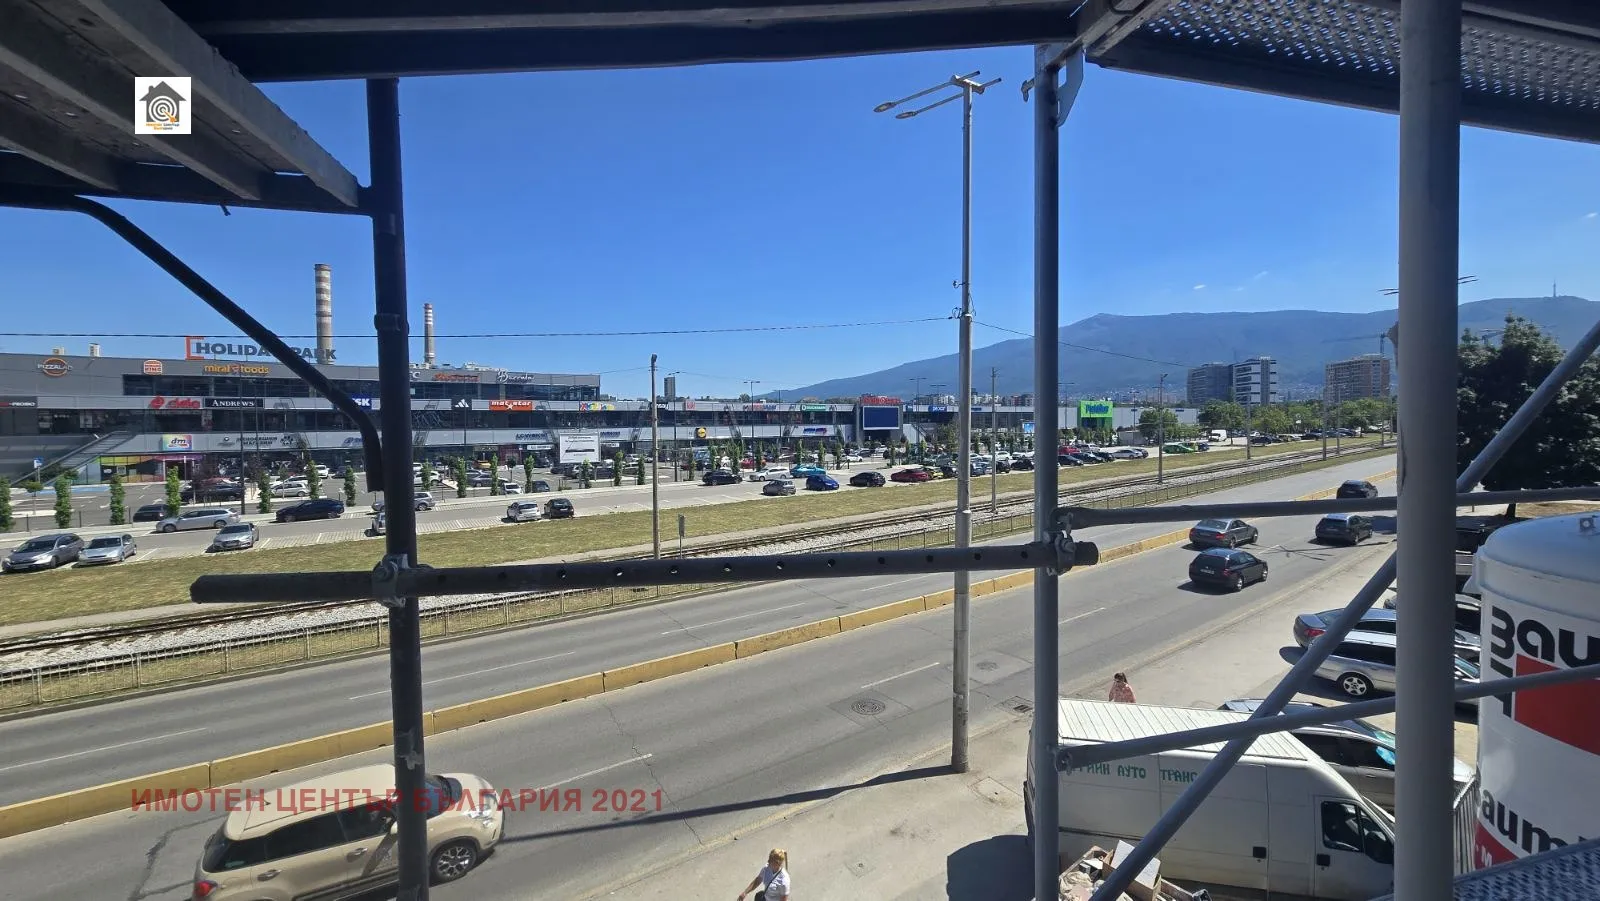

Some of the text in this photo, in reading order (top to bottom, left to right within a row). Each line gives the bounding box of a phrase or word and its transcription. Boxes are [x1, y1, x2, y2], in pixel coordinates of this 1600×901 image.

[195, 342, 272, 357] HOLIDA
[211, 398, 255, 407] ANDREWS
[352, 397, 371, 407] SK
[1117, 764, 1146, 779] АУТО
